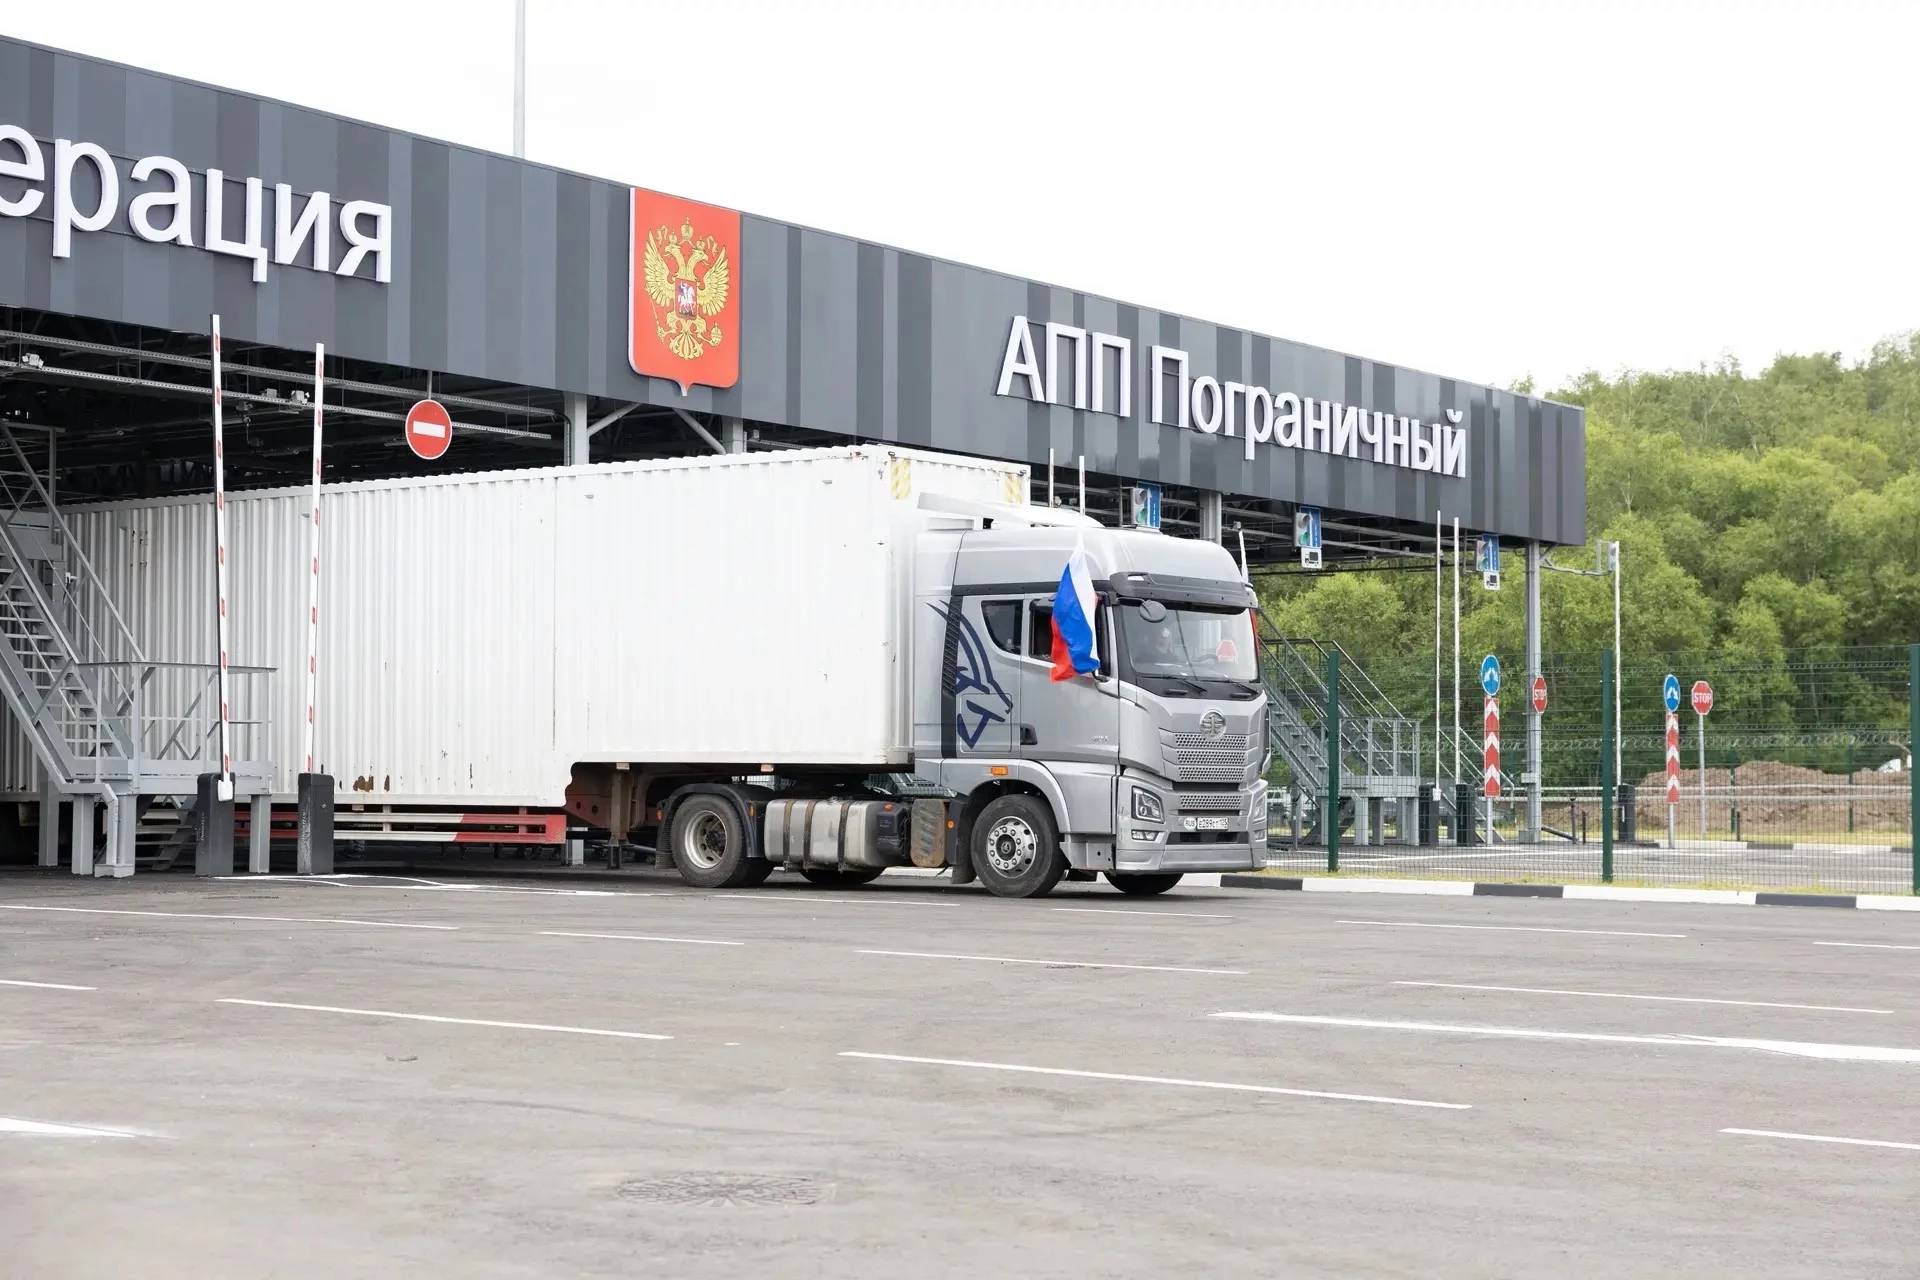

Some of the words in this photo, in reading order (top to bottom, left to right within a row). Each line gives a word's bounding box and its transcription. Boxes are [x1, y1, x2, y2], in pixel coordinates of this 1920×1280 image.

[996, 315, 1131, 418] АПП
[1151, 345, 1467, 478] Пограничный
[1534, 688, 1547, 700] STOP
[1693, 692, 1712, 703] STOP
[1185, 819, 1196, 827] RUS
